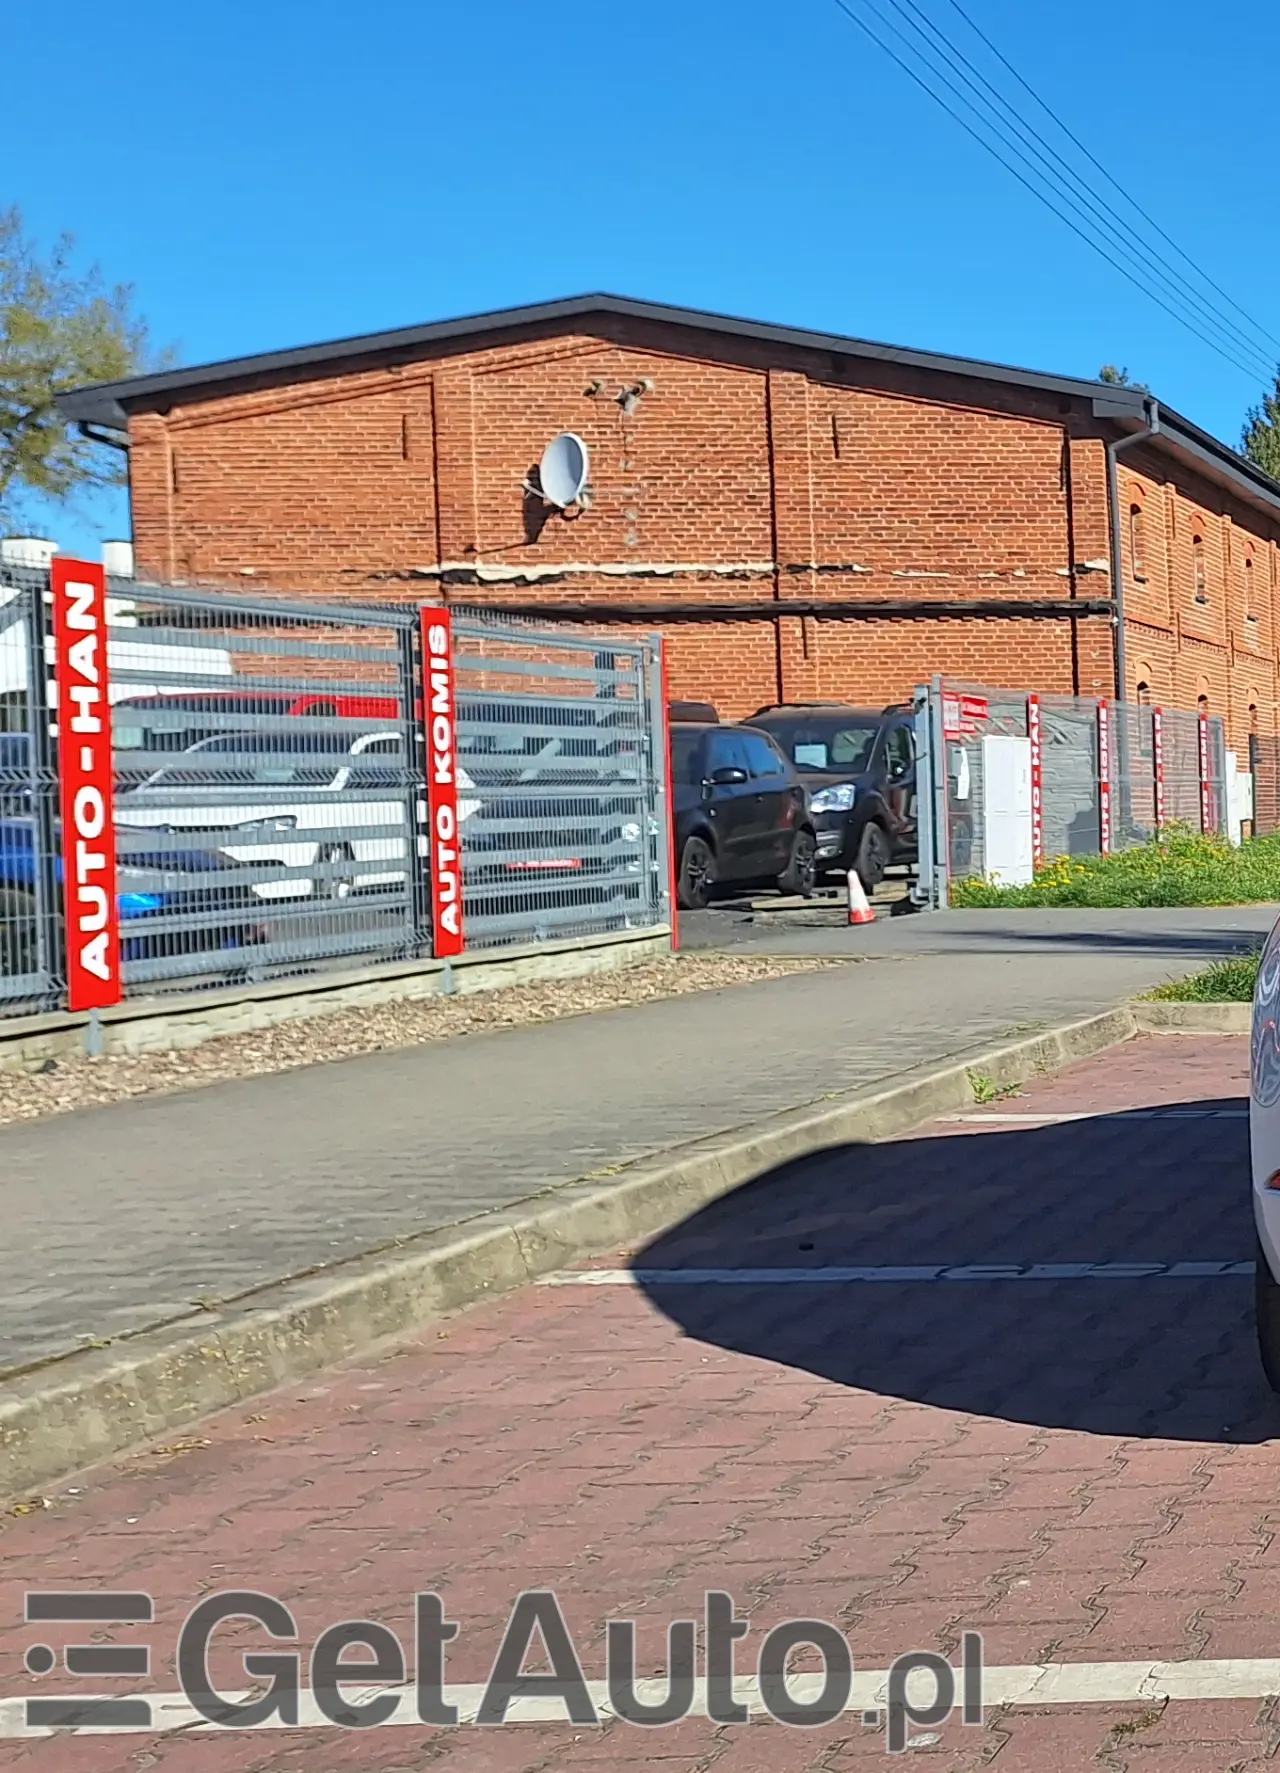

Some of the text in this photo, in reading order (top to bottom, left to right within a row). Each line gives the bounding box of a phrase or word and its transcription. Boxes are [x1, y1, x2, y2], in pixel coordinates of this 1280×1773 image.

[65, 581, 102, 733] HAN
[428, 624, 459, 935] AUTO KOMIS
[74, 785, 110, 981] AUTO
